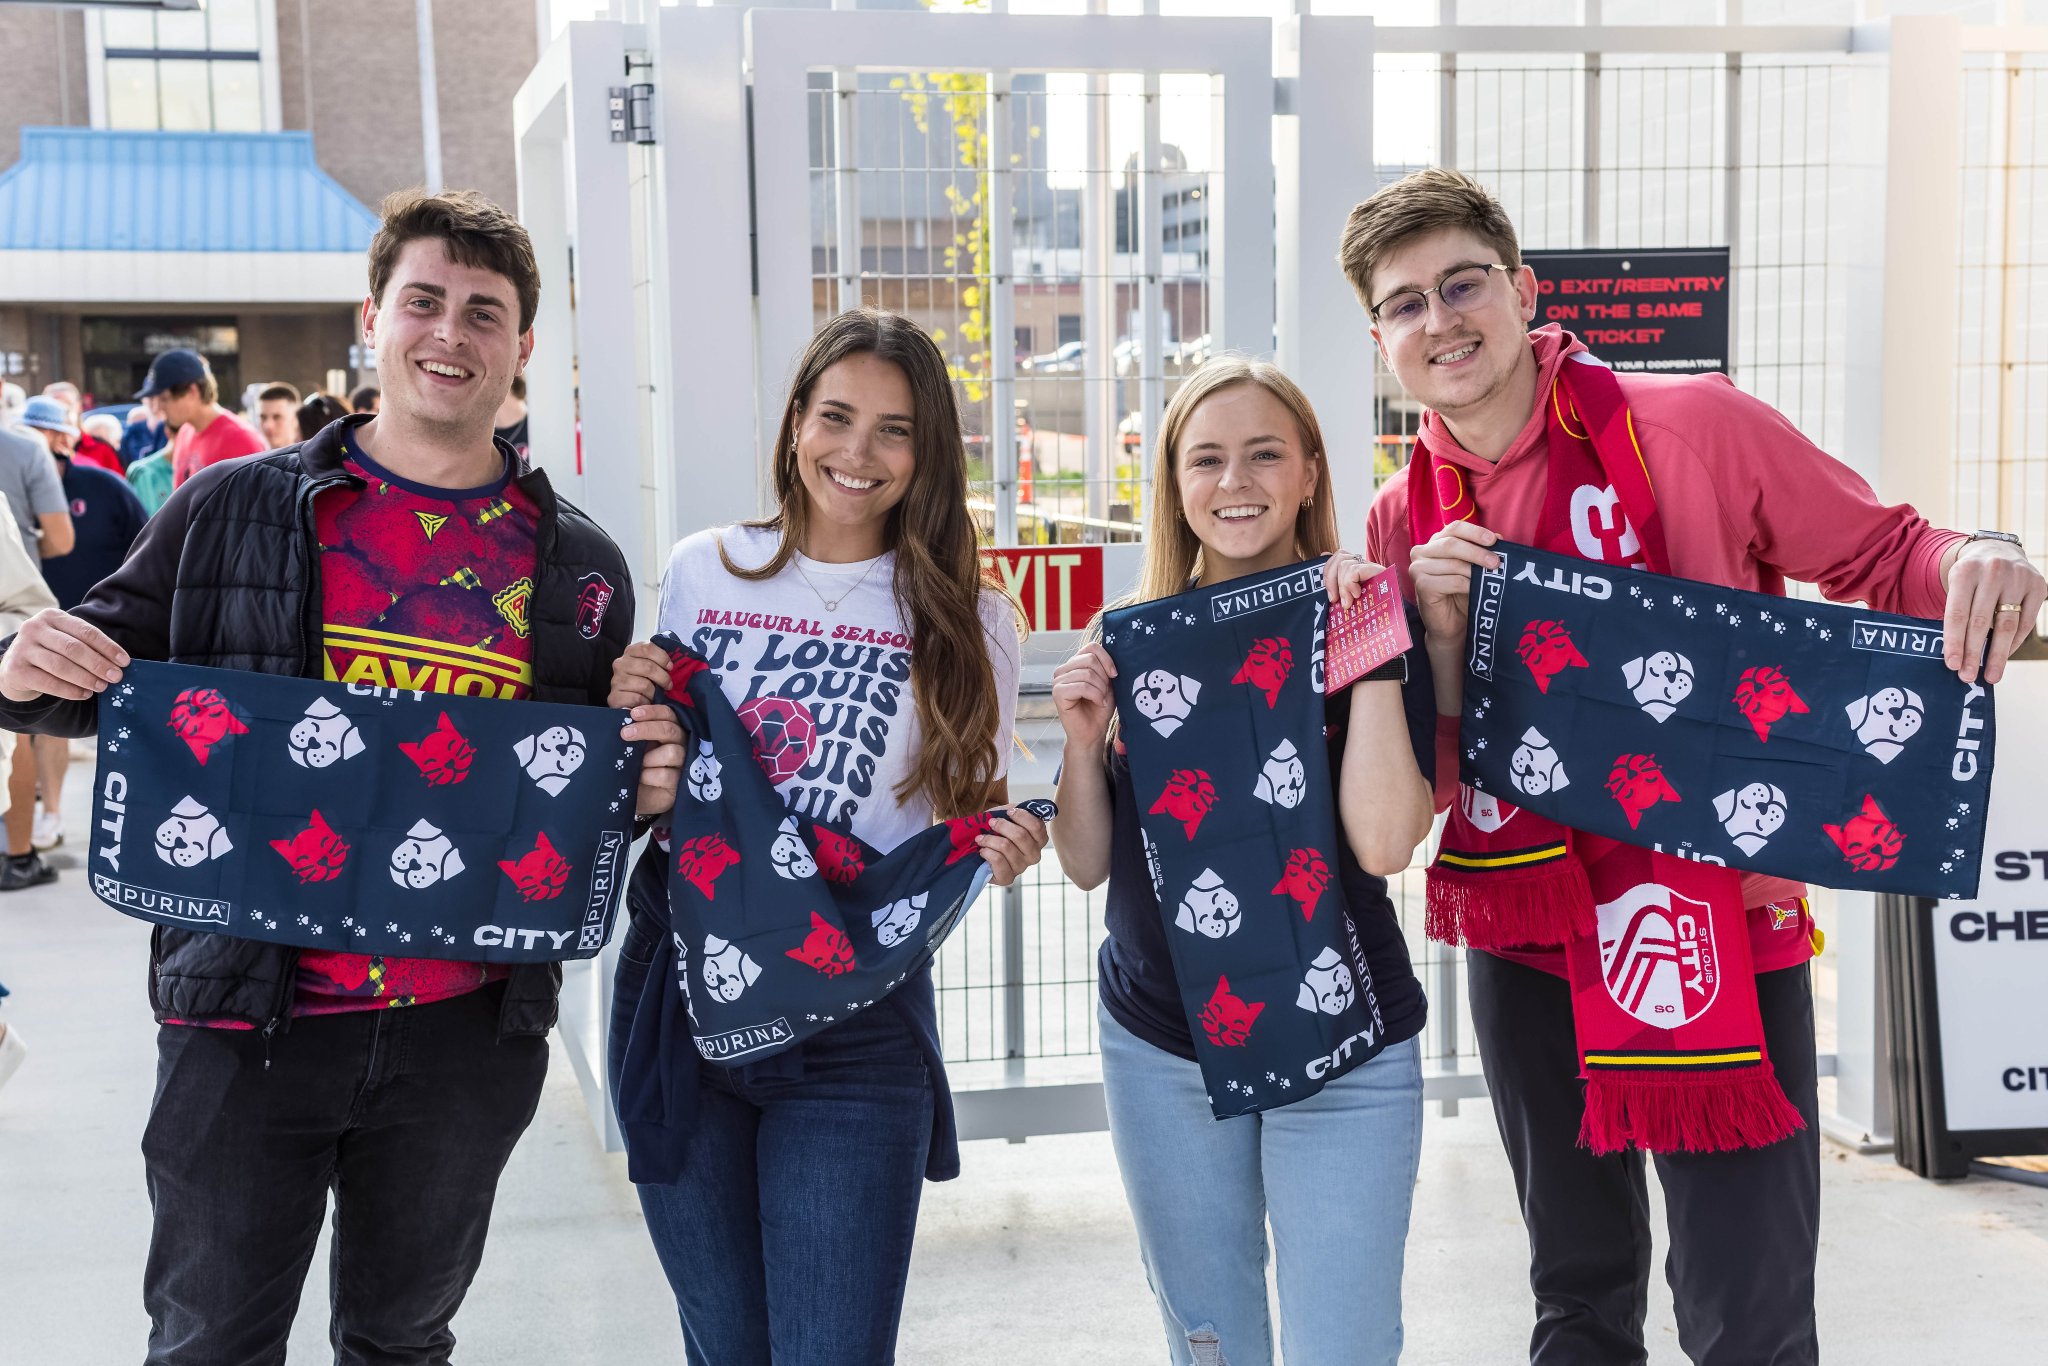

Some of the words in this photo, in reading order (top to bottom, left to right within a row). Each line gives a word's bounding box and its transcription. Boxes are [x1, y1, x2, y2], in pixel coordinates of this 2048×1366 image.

[1537, 280, 1555, 295] O
[1560, 276, 1726, 296] EXIT/REENTRY
[1546, 305, 1579, 320] ON
[1585, 303, 1631, 319] THE
[1637, 302, 1703, 319] SAME
[1583, 328, 1665, 345] TICKET
[1614, 360, 1645, 370] YOUR
[1646, 358, 1722, 370] COOPERATION
[980, 554, 1082, 632] XIT
[1218, 575, 1307, 615] PURINA
[1512, 561, 1613, 601] CITY
[696, 608, 824, 637] INAUGURAL
[1476, 581, 1501, 671] PURINA
[689, 626, 743, 672] ST.
[754, 634, 912, 682] LOUIS
[1861, 627, 1944, 654] URINA
[809, 702, 889, 758] UIS
[1951, 682, 1986, 782] CITY
[99, 771, 128, 873] CITY
[1480, 808, 1493, 818] SC
[588, 837, 619, 922] PURINA
[124, 887, 223, 918] PURINA
[473, 924, 575, 950] CITY
[1699, 927, 1709, 944] ST
[1949, 910, 2048, 942] CHE
[1345, 919, 1377, 1004] PURINA
[1676, 914, 1706, 997] CITY
[1701, 948, 1714, 984] LOUIS
[1654, 1004, 1675, 1014] SC
[706, 1026, 787, 1055] PURINA
[1305, 1020, 1376, 1080] CITY
